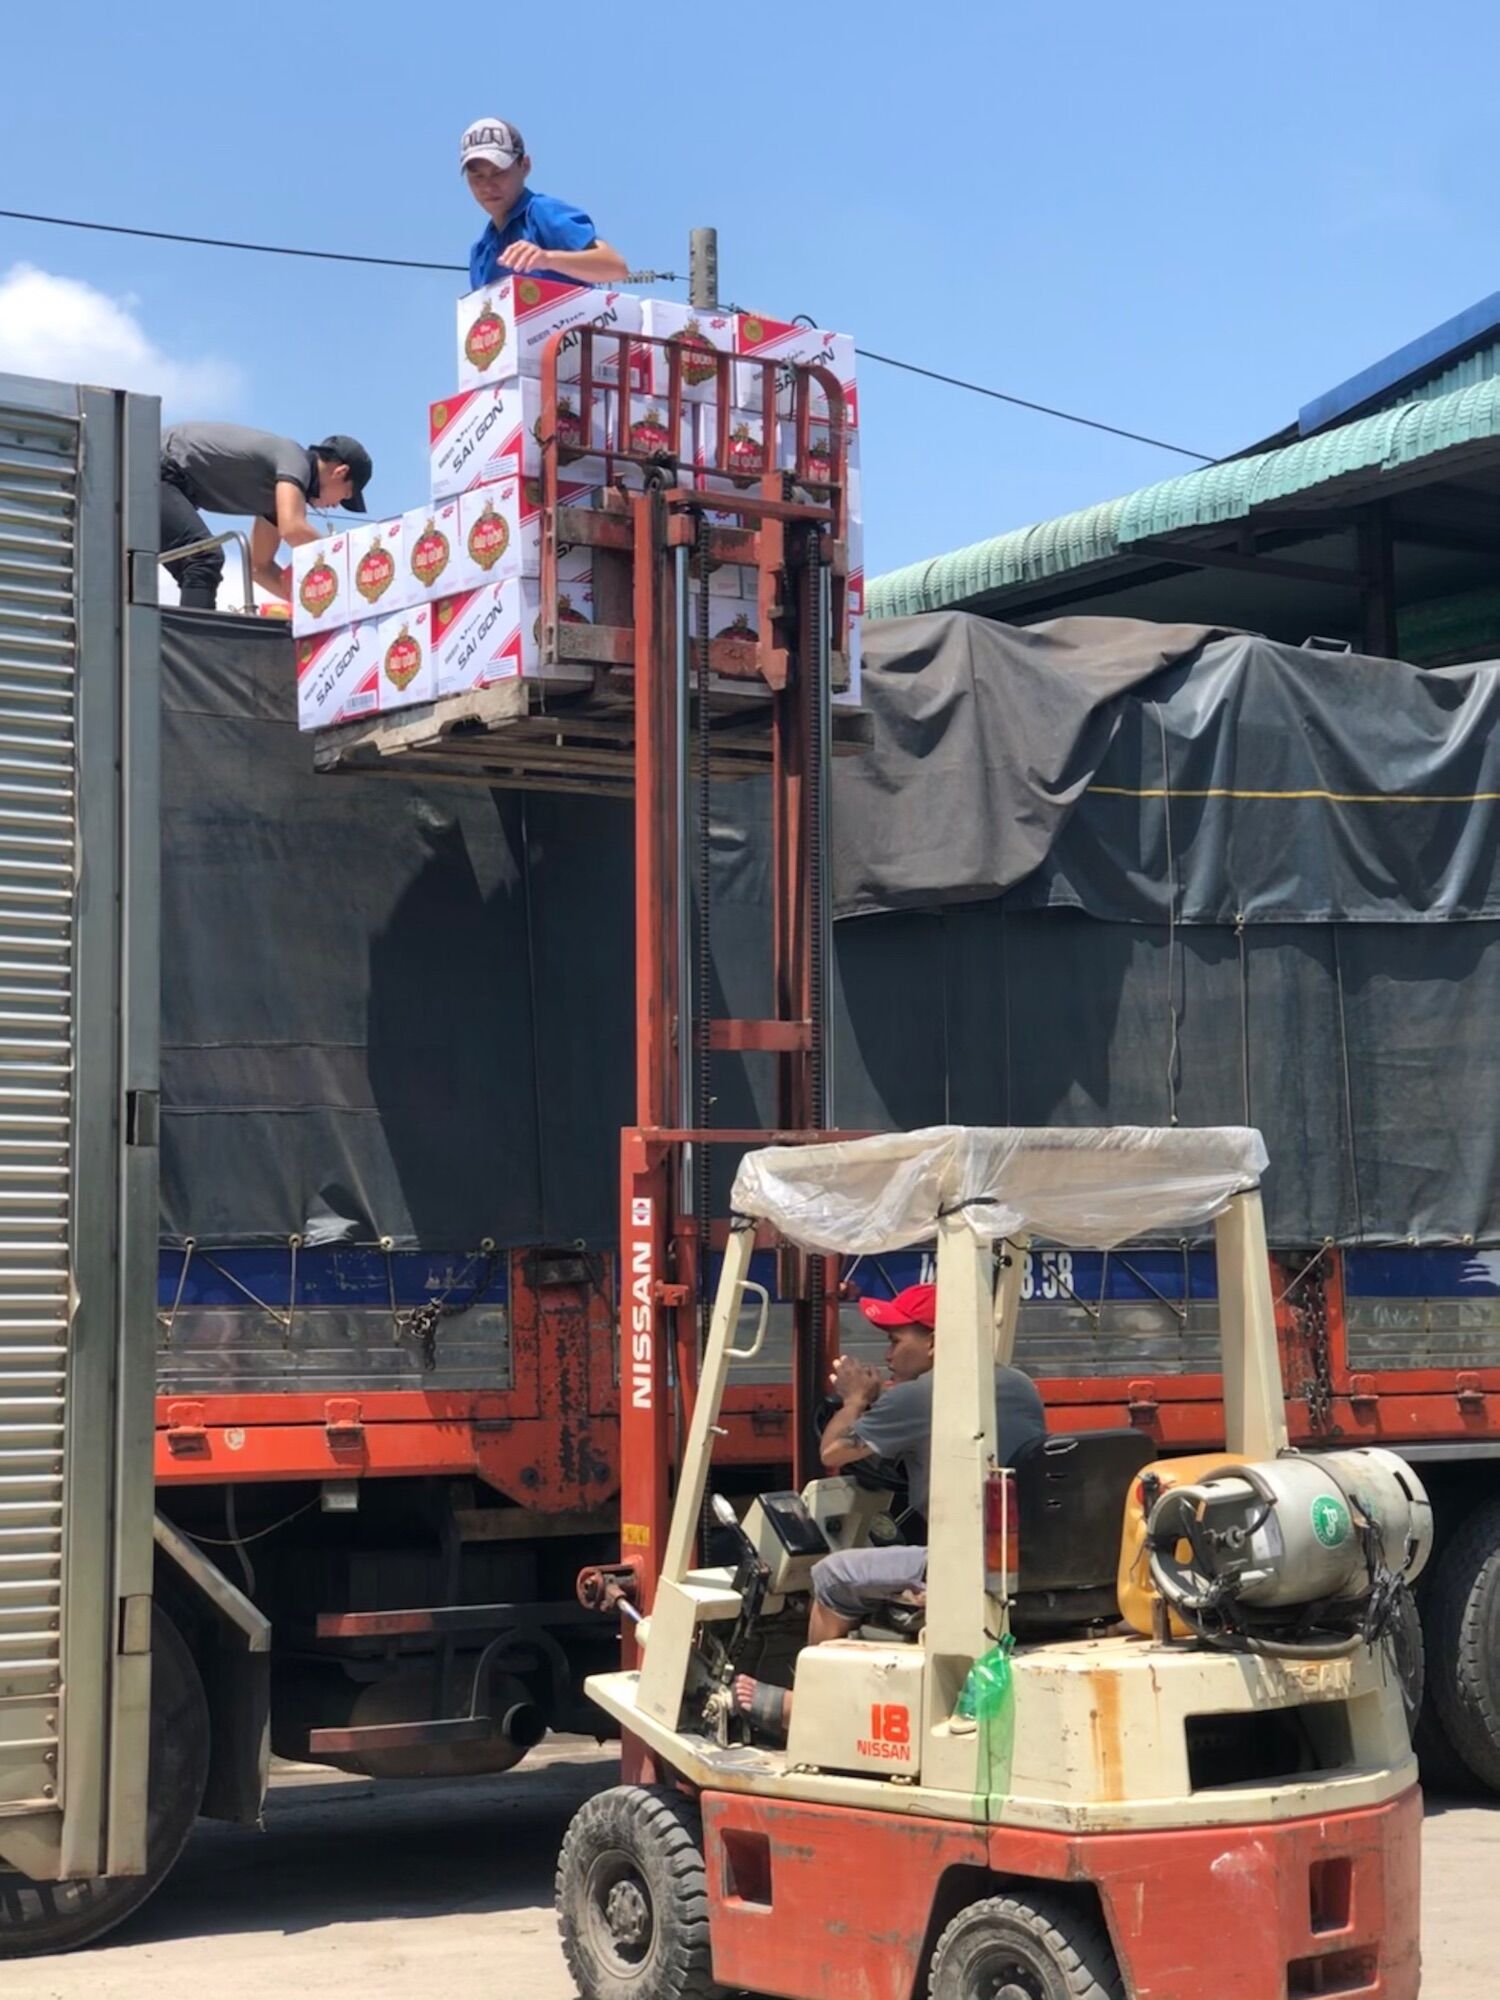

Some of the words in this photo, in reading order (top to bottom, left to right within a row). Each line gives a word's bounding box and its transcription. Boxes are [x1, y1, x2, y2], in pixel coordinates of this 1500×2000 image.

[453, 438, 474, 474] SAI
[475, 399, 504, 442] GON
[457, 636, 477, 671] SAI
[477, 600, 503, 640] GON
[316, 674, 335, 707] SAI
[335, 639, 360, 678] GON
[632, 1242, 652, 1409] NISSAN
[857, 1740, 910, 1761] NISSAN
[871, 1704, 910, 1743] 18
